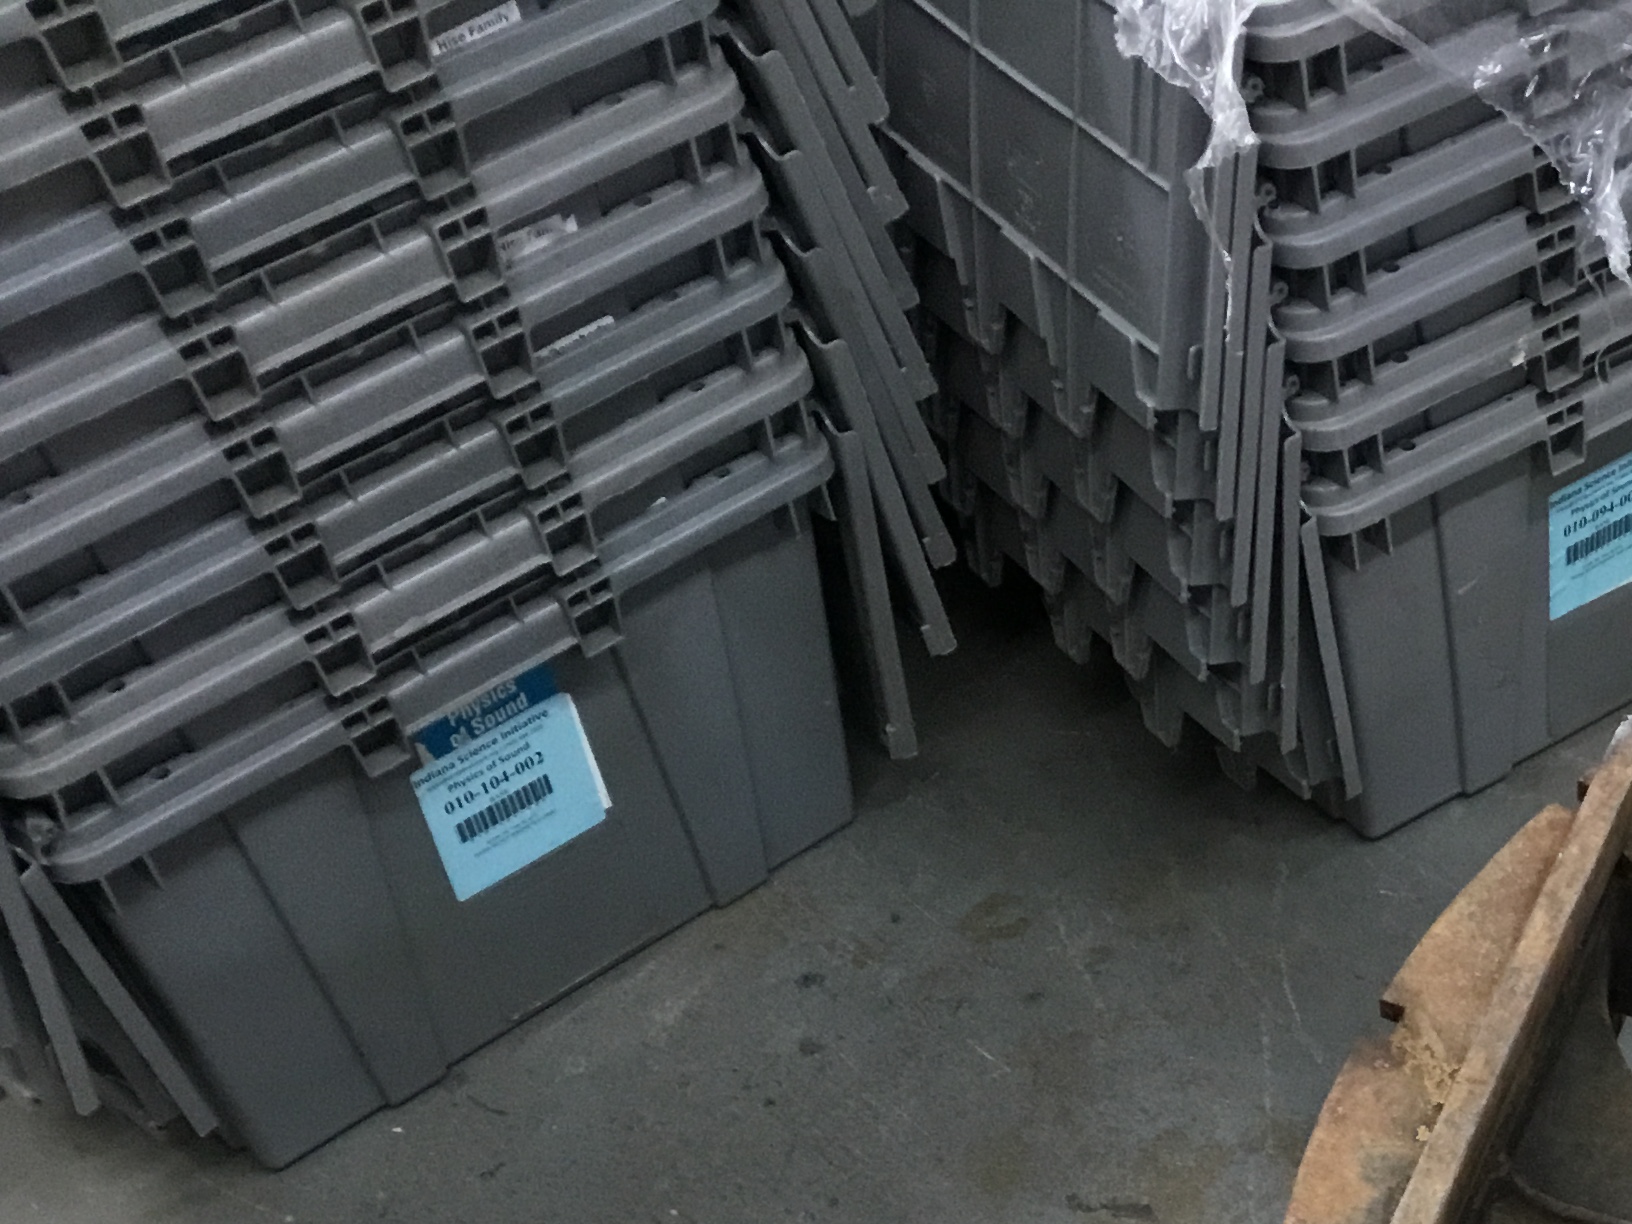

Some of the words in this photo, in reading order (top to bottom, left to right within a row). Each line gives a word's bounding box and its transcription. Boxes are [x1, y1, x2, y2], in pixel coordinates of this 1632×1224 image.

[448, 679, 518, 727] Physics
[470, 692, 529, 736] Sound
[412, 761, 456, 789] Indiana
[457, 737, 499, 765] Science
[500, 708, 549, 741] Initiative
[446, 770, 484, 793] Physics
[485, 759, 498, 772] of
[498, 741, 531, 763] Sound
[443, 750, 545, 815] 010-104-002
